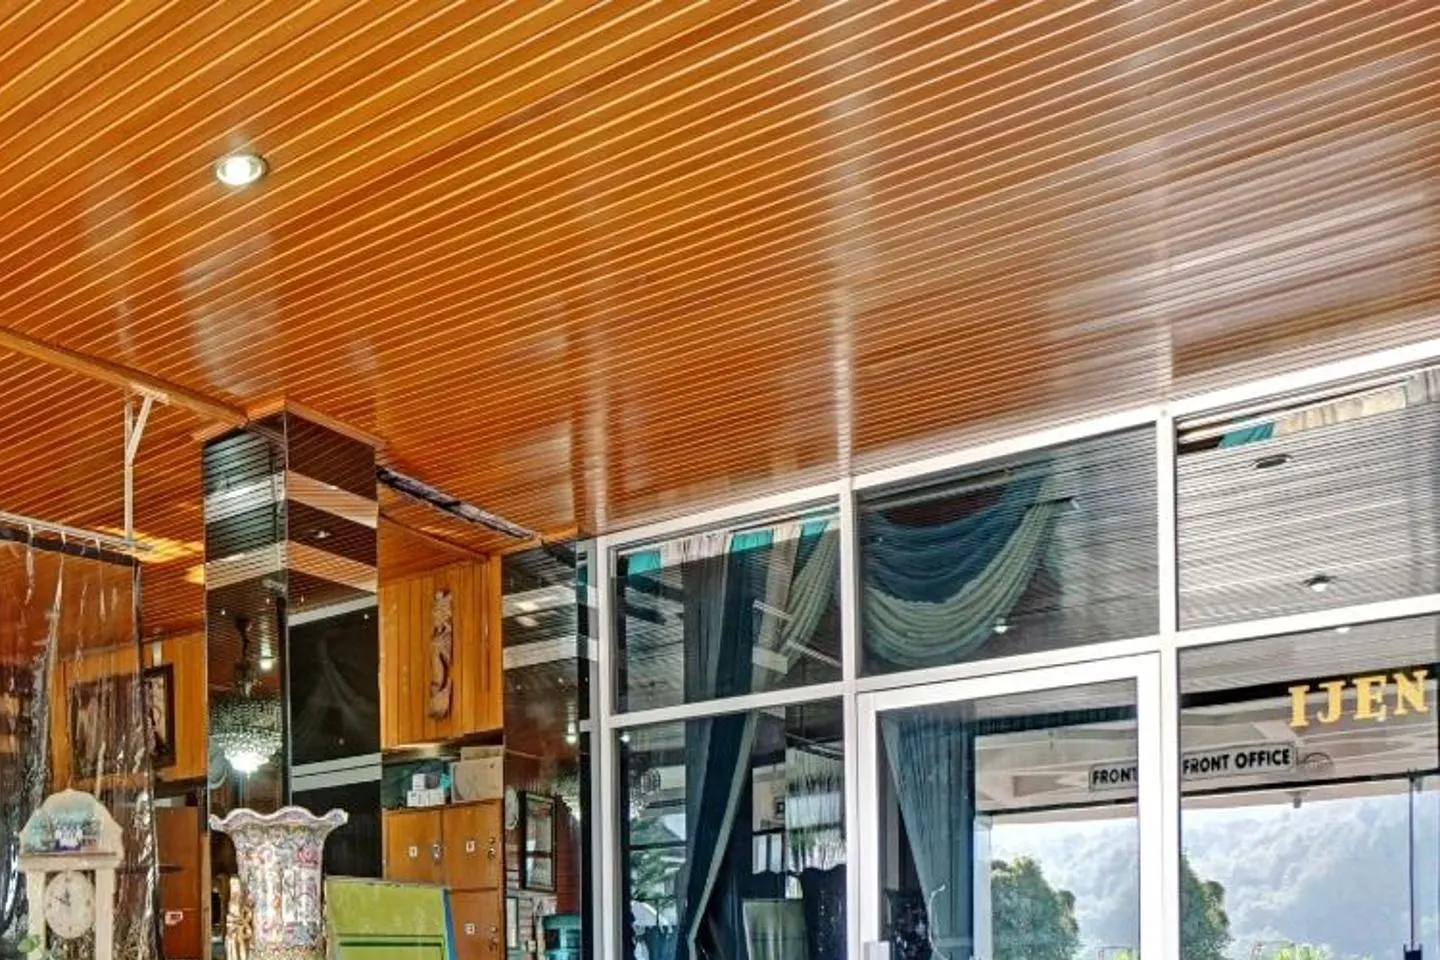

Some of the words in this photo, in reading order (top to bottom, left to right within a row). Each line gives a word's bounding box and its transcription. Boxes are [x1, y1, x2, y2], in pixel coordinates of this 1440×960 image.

[1288, 669, 1429, 727] IJEN
[1182, 753, 1230, 774] FRONT
[1235, 748, 1290, 769] OFFICE
